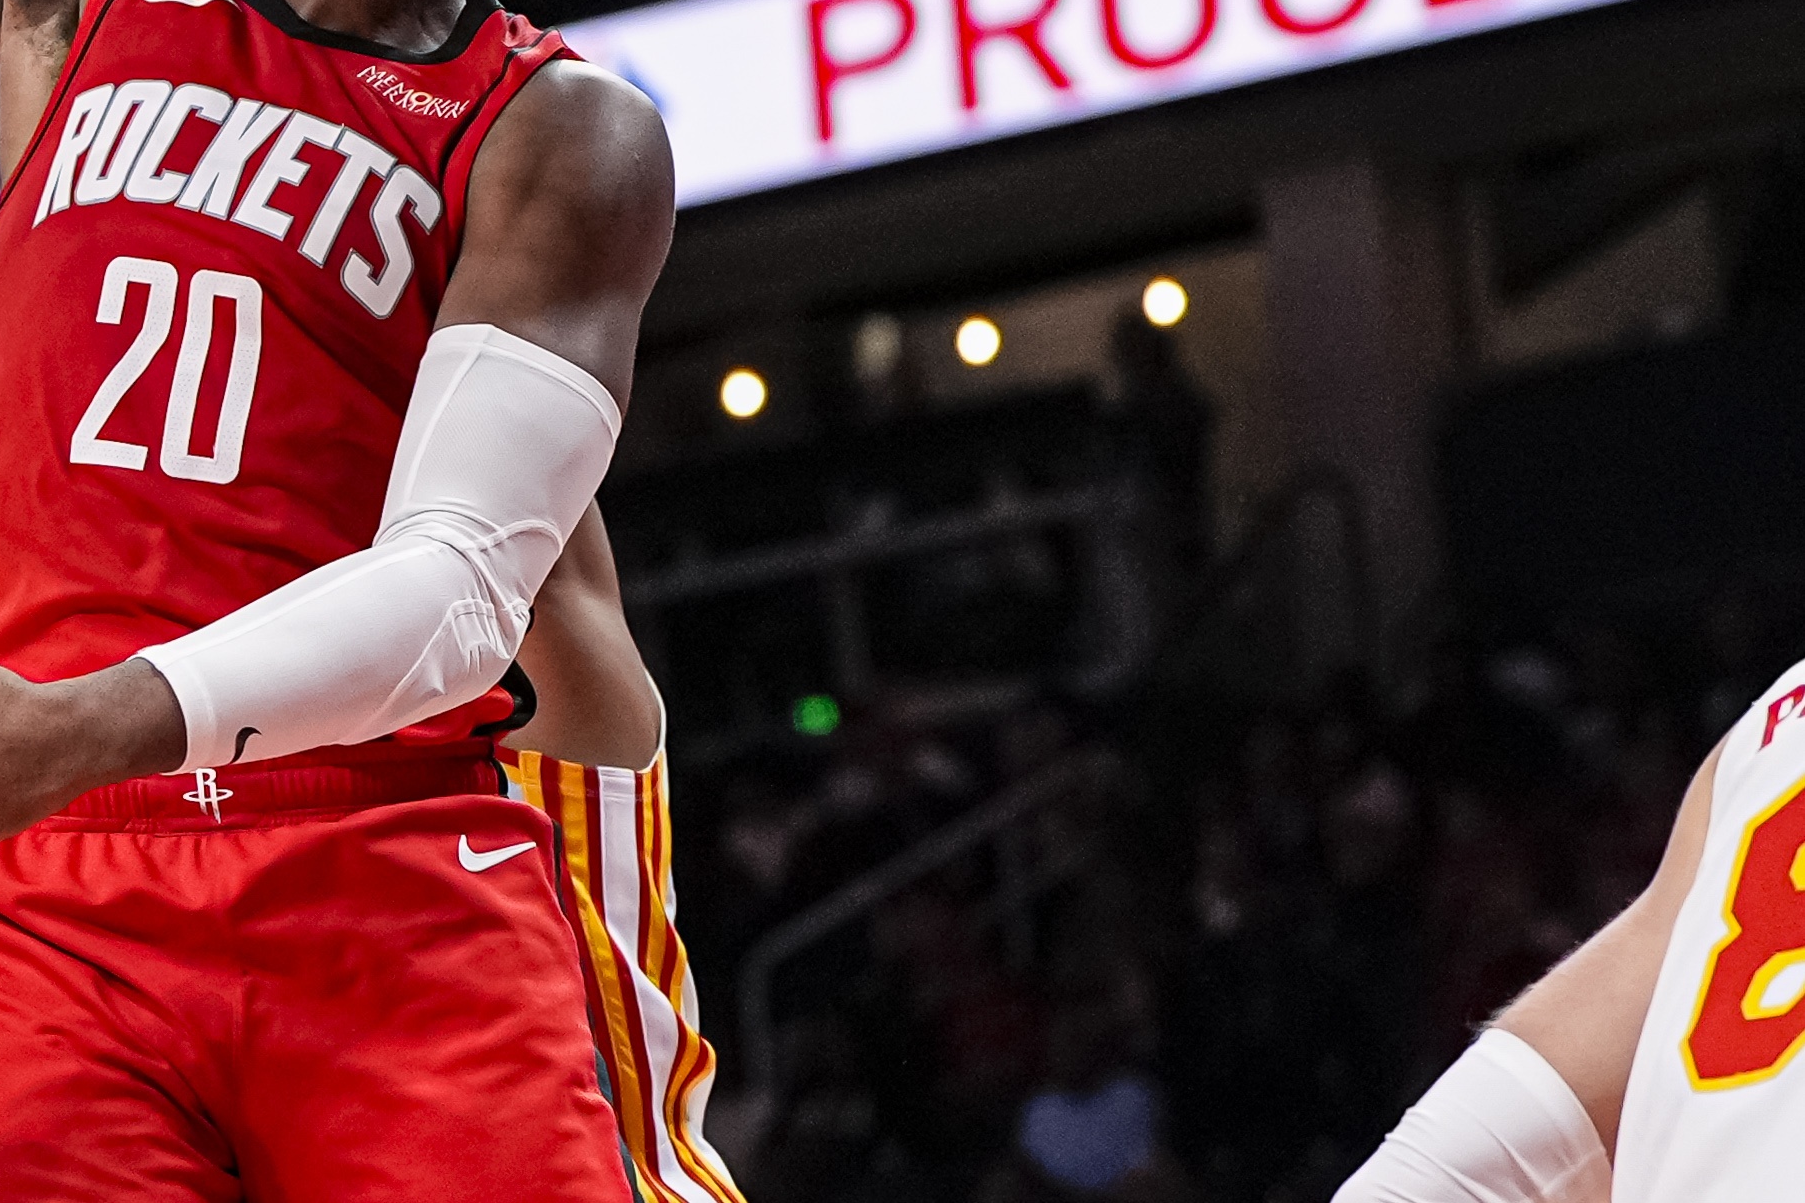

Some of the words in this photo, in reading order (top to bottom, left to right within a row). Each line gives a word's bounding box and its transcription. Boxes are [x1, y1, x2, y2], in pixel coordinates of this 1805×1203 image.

[32, 79, 445, 319] ROCKETS
[69, 255, 263, 485] 20
[1757, 683, 1805, 753] P
